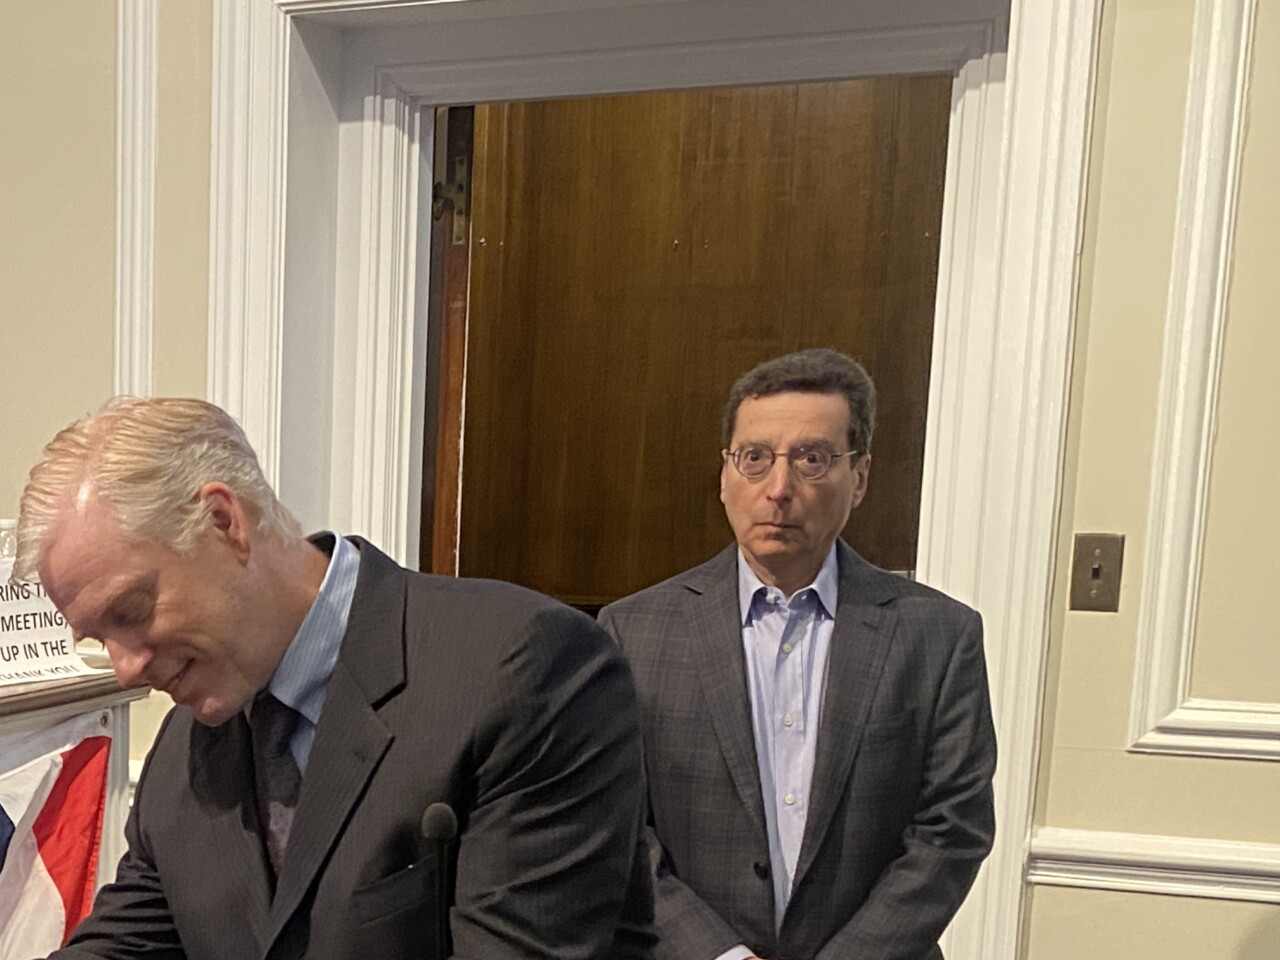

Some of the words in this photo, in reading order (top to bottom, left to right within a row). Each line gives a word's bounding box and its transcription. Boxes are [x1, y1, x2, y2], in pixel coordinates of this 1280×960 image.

[0, 645, 19, 662] UP
[23, 642, 39, 659] IN
[40, 640, 69, 657] THE
